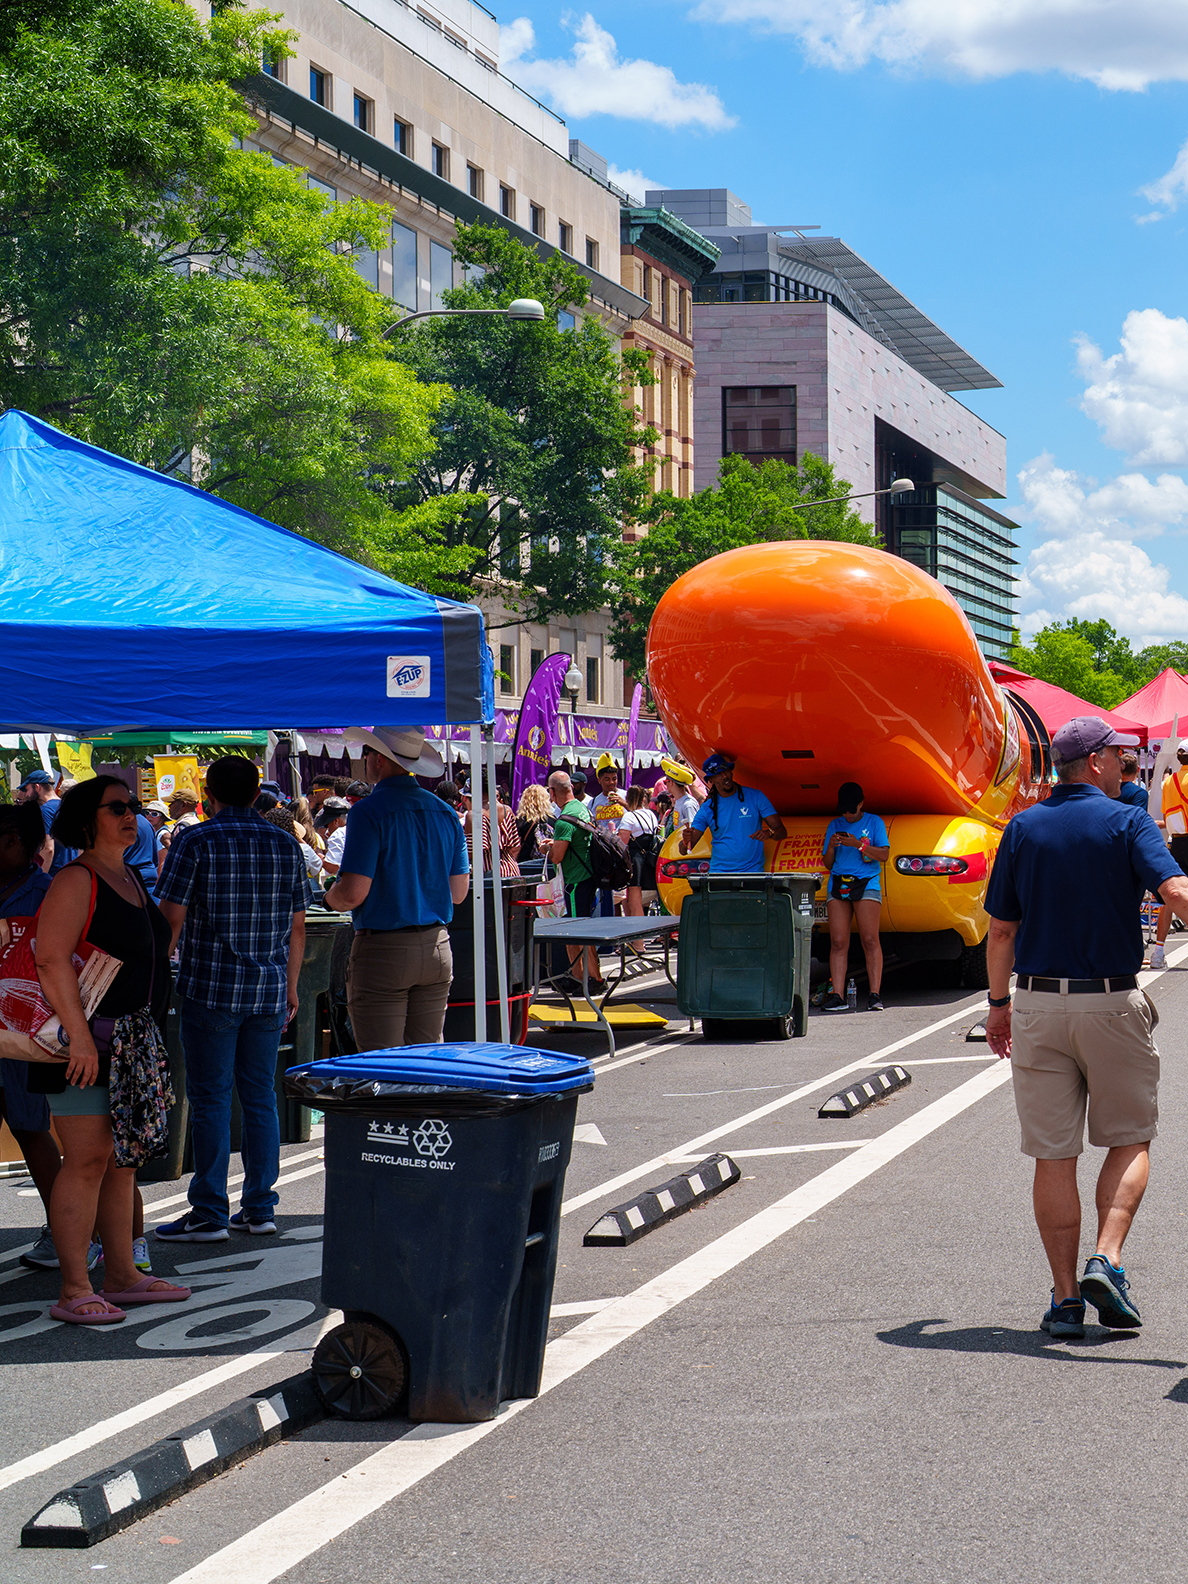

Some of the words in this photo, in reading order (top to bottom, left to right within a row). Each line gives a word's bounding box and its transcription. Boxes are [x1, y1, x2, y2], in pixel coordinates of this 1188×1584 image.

[518, 745, 550, 768] Annie's
[596, 811, 623, 820] BURGER
[603, 804, 623, 813] GOOD
[361, 1152, 427, 1169] RECYCLABLES
[429, 1160, 456, 1171] ONLY
